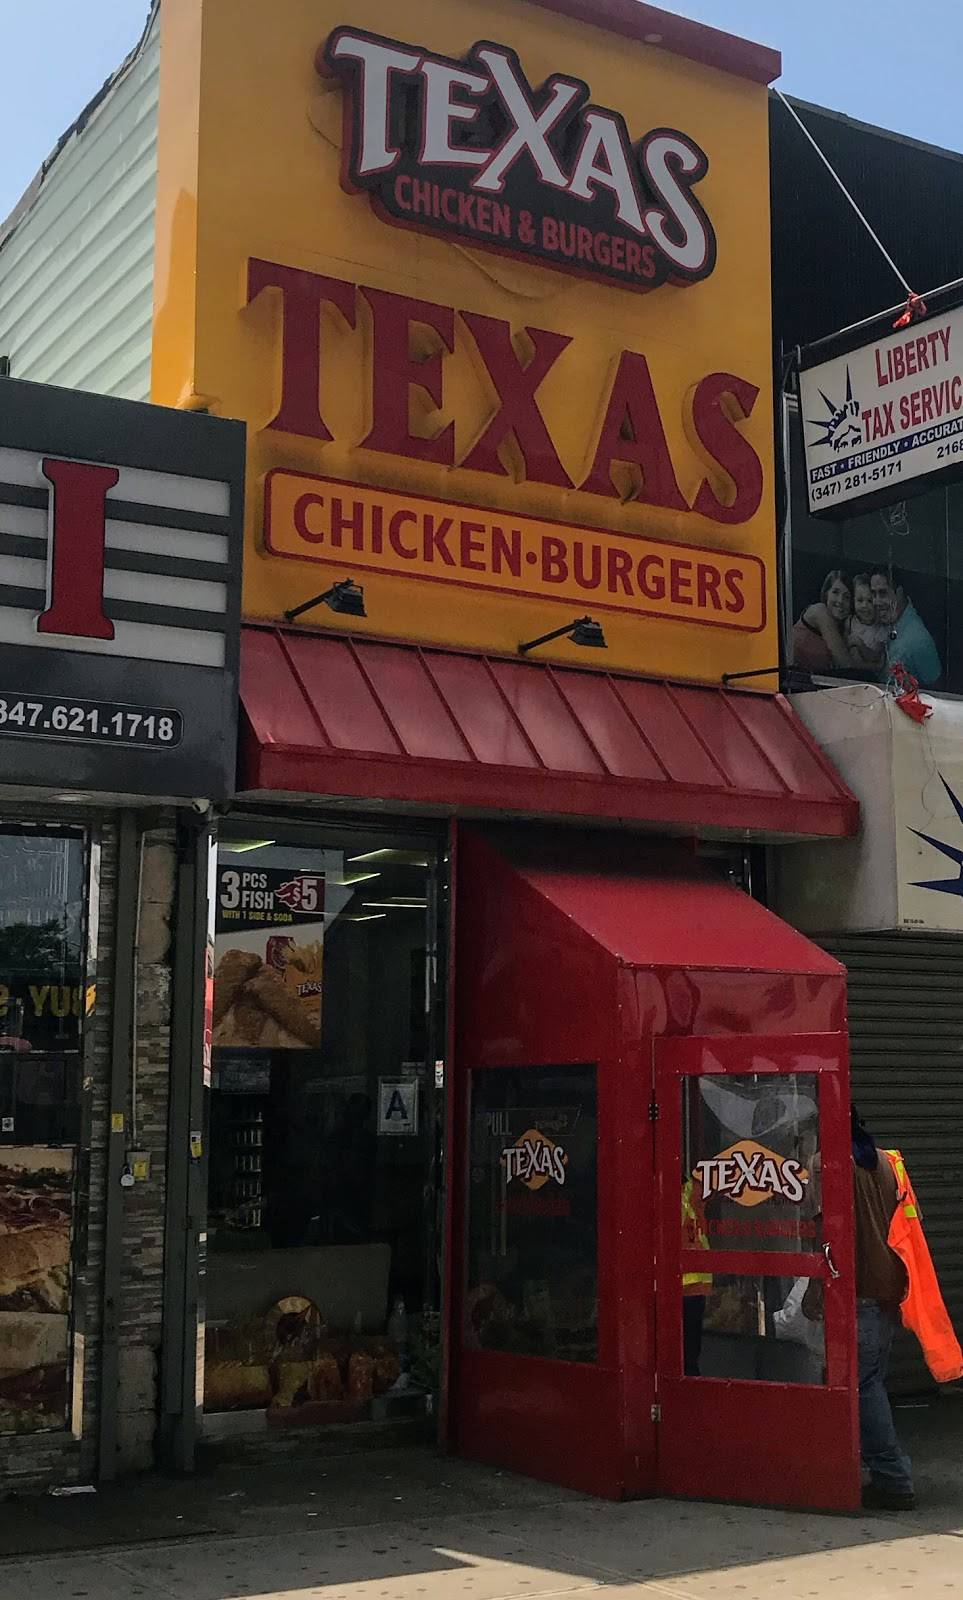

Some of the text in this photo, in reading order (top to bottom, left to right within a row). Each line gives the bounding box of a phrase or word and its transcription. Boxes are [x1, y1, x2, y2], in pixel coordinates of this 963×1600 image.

[334, 36, 708, 270] TEXAS
[394, 174, 657, 279] CHICKEN & BURGERS
[247, 257, 764, 524] TEXAS
[861, 376, 962, 442] TAX SERVIC
[811, 463, 838, 482] FAST
[848, 441, 900, 469] FRIENDLY
[811, 460, 902, 502] (347) 281-5171
[220, 870, 240, 909] 3
[242, 872, 268, 889] PCS
[242, 890, 274, 910] FISH
[222, 909, 240, 919] WITH
[385, 1089, 409, 1120] A
[502, 1140, 566, 1185] TEXAS
[696, 1152, 803, 1202] TEXAS
